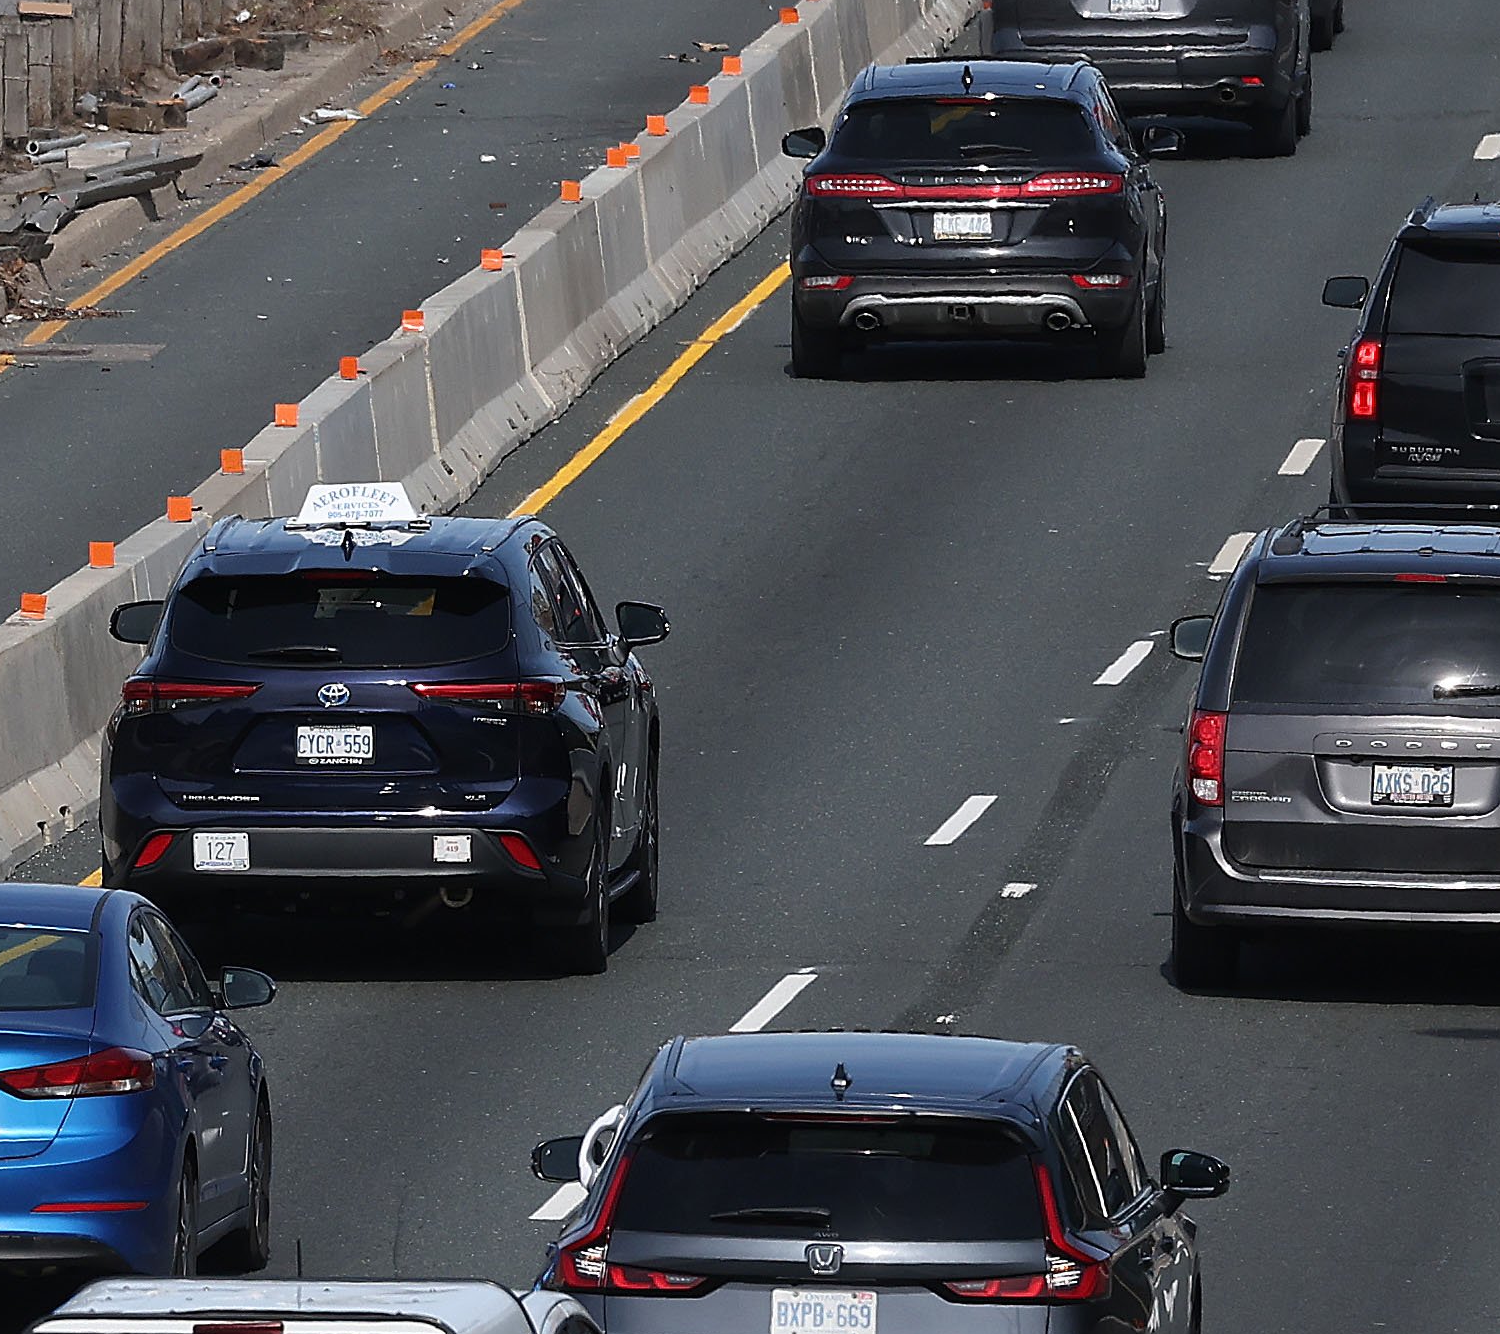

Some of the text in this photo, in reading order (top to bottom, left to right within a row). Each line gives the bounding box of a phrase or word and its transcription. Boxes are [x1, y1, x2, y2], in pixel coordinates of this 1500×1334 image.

[311, 485, 400, 512] AEROFLEET
[331, 500, 380, 510] SERVICES
[297, 733, 371, 755] CYCR 559
[319, 757, 363, 765] ZANCHIN
[207, 841, 236, 861] 127
[837, 1304, 872, 1329] 669
